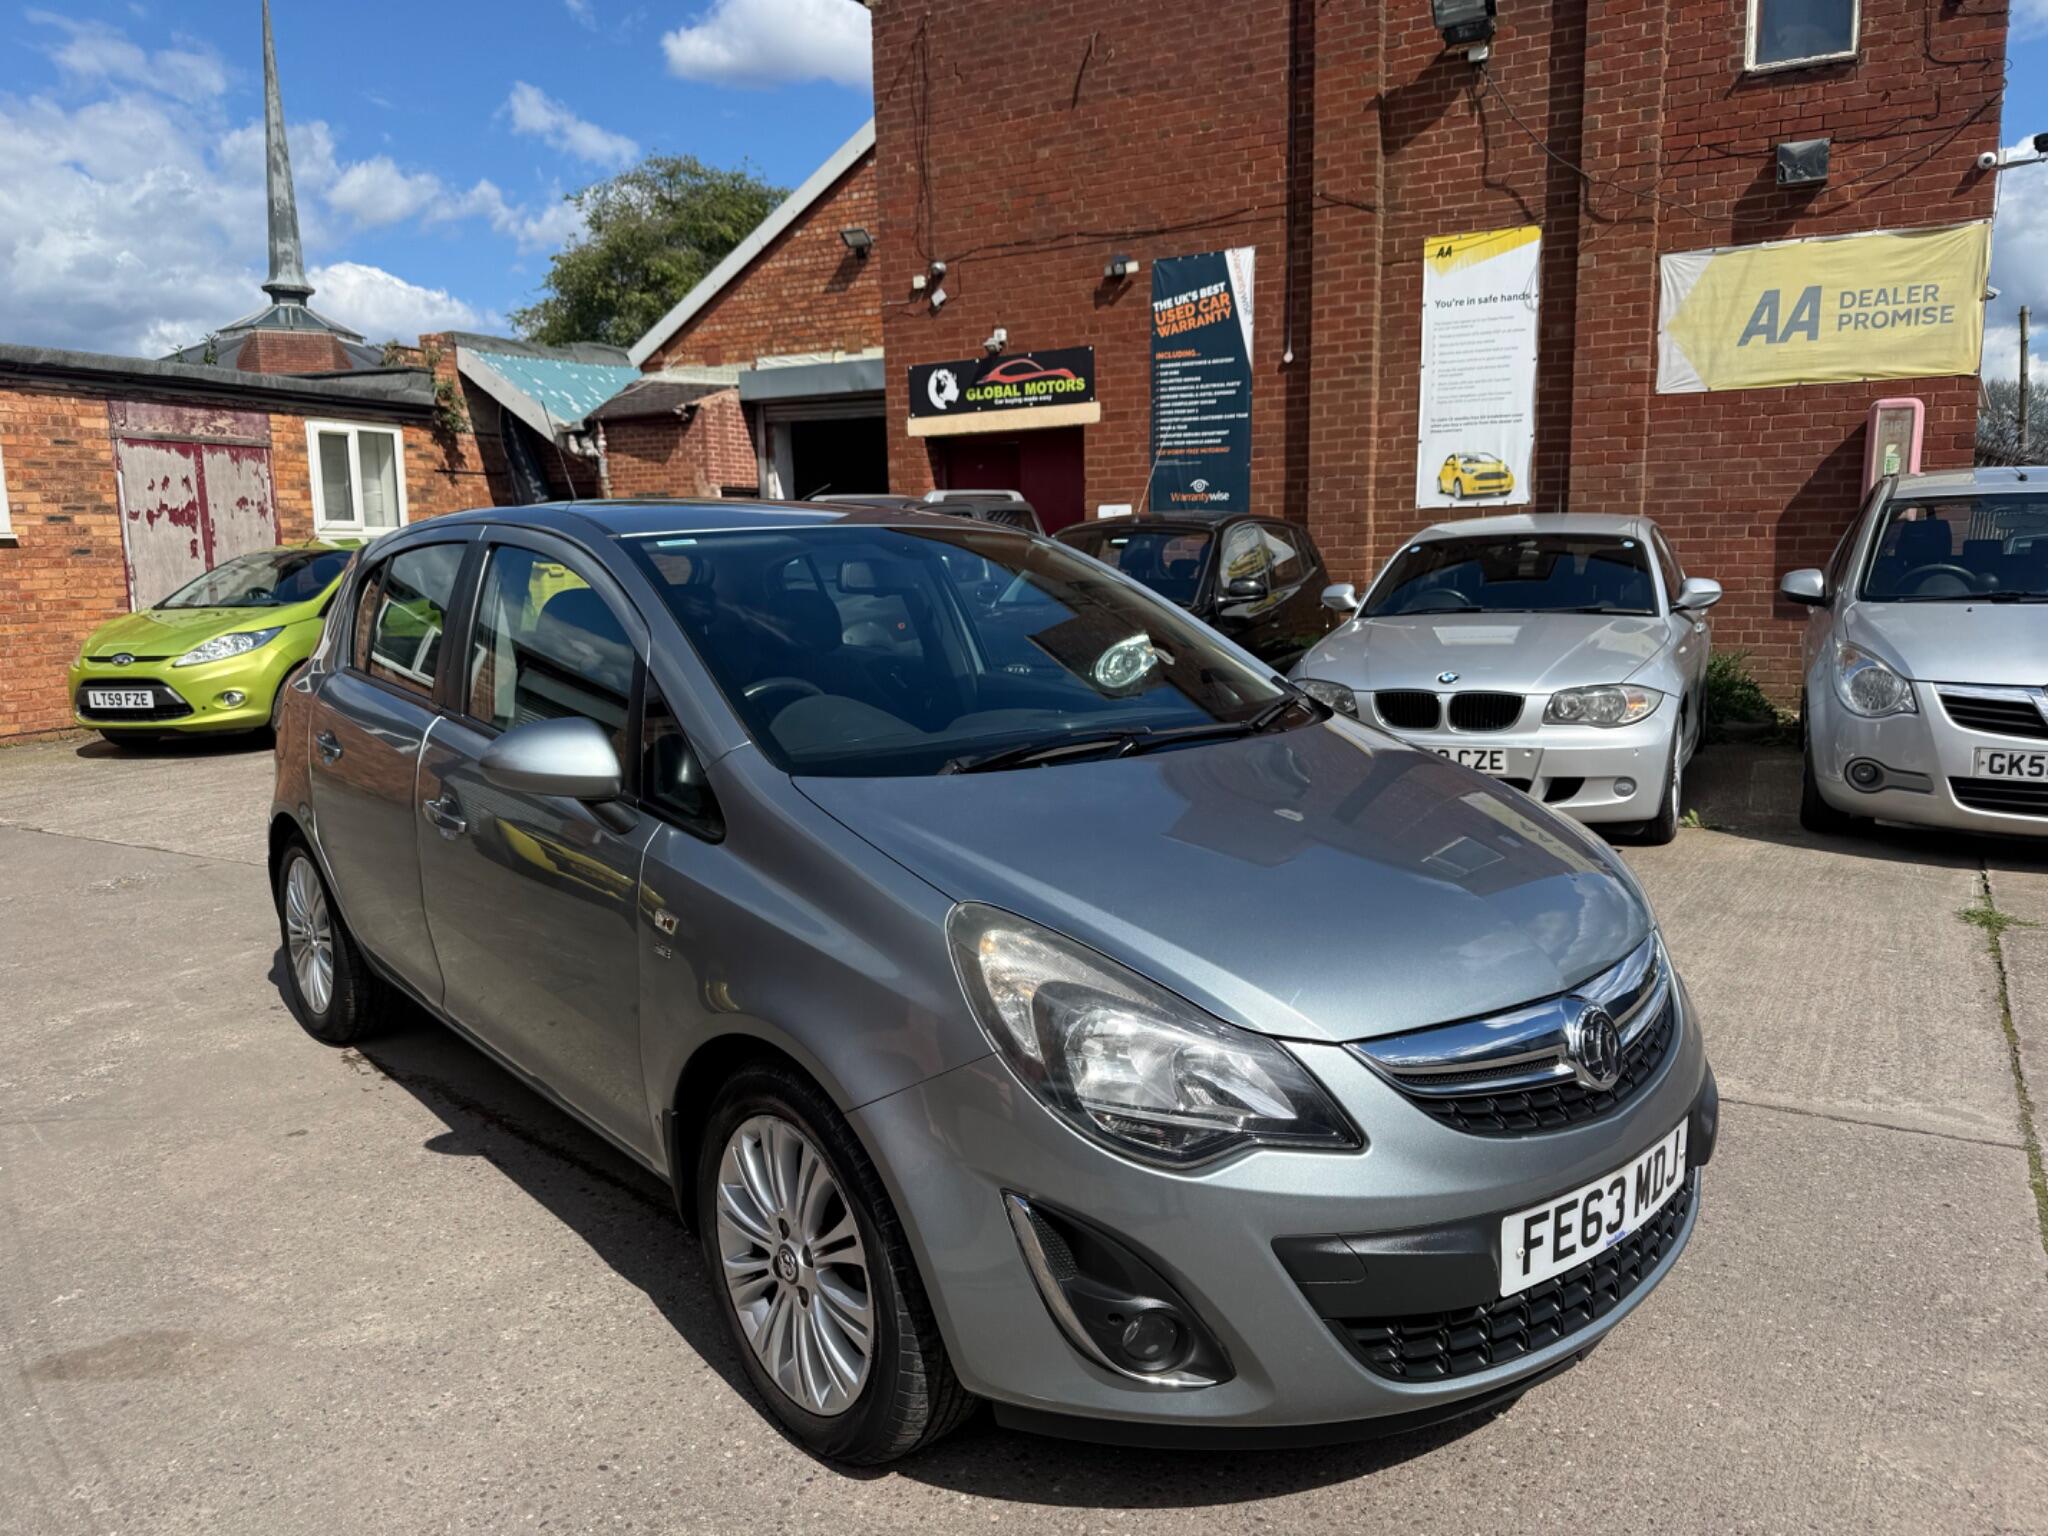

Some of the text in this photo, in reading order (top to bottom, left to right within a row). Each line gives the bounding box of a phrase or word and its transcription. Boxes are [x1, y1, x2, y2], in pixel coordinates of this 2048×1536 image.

[1436, 245, 1452, 258] AA
[1152, 281, 1226, 312] THE UK'S BEST
[1154, 292, 1231, 326] USED CAR
[1434, 298, 1465, 309] You're
[1466, 296, 1476, 305] in
[1478, 294, 1499, 304] safe
[1839, 284, 1939, 310] DEALER
[1156, 305, 1232, 338] WARRANTY
[1737, 285, 1822, 347] AA
[1837, 305, 1955, 332] PROMISE
[966, 377, 1086, 401] GLOBAL MOTORS
[1169, 490, 1230, 504] Warrantywise
[92, 692, 149, 706] LT59 FZE
[1458, 749, 1504, 770] CZE
[1988, 752, 2048, 778] GK5
[1522, 1129, 1681, 1277] FE63 MDJ
